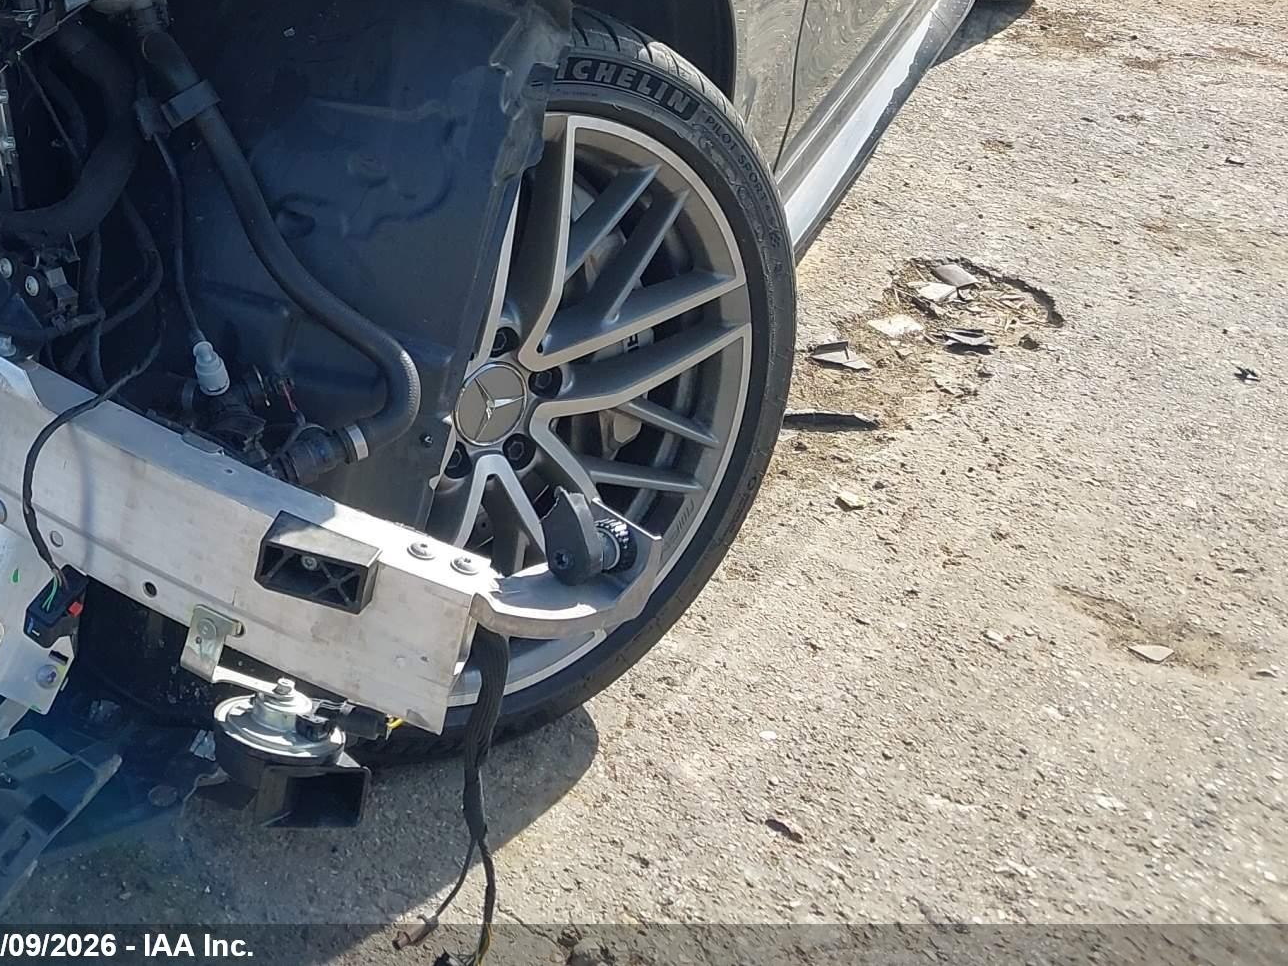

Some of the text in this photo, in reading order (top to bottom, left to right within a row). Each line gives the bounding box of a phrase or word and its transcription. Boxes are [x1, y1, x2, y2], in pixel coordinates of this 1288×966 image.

[556, 58, 688, 115] ICHELIN
[705, 115, 768, 202] PILOT SPORT
